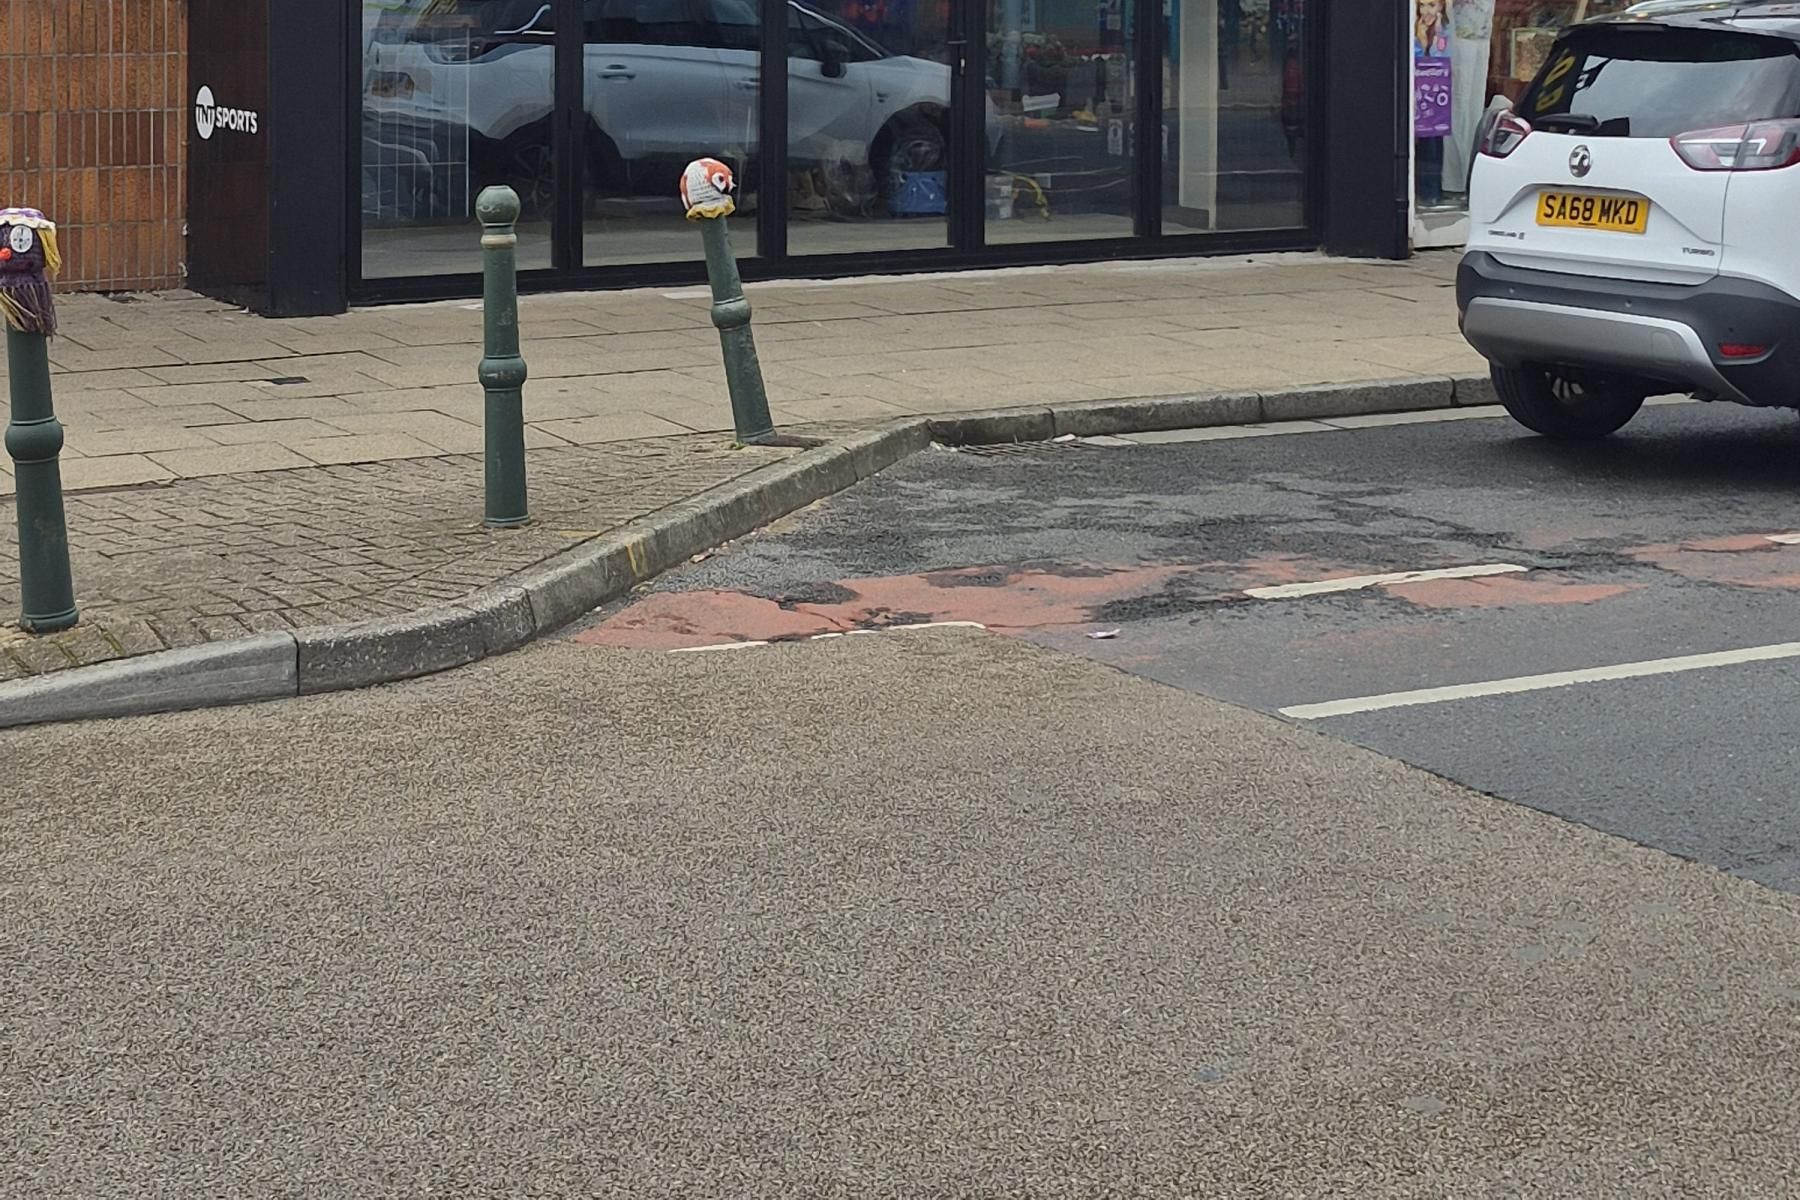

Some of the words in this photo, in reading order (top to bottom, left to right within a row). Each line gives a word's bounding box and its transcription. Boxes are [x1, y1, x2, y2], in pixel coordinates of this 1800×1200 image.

[215, 106, 258, 134] SPORTS
[1543, 195, 1596, 222] SA68
[1598, 199, 1639, 225] MKD
